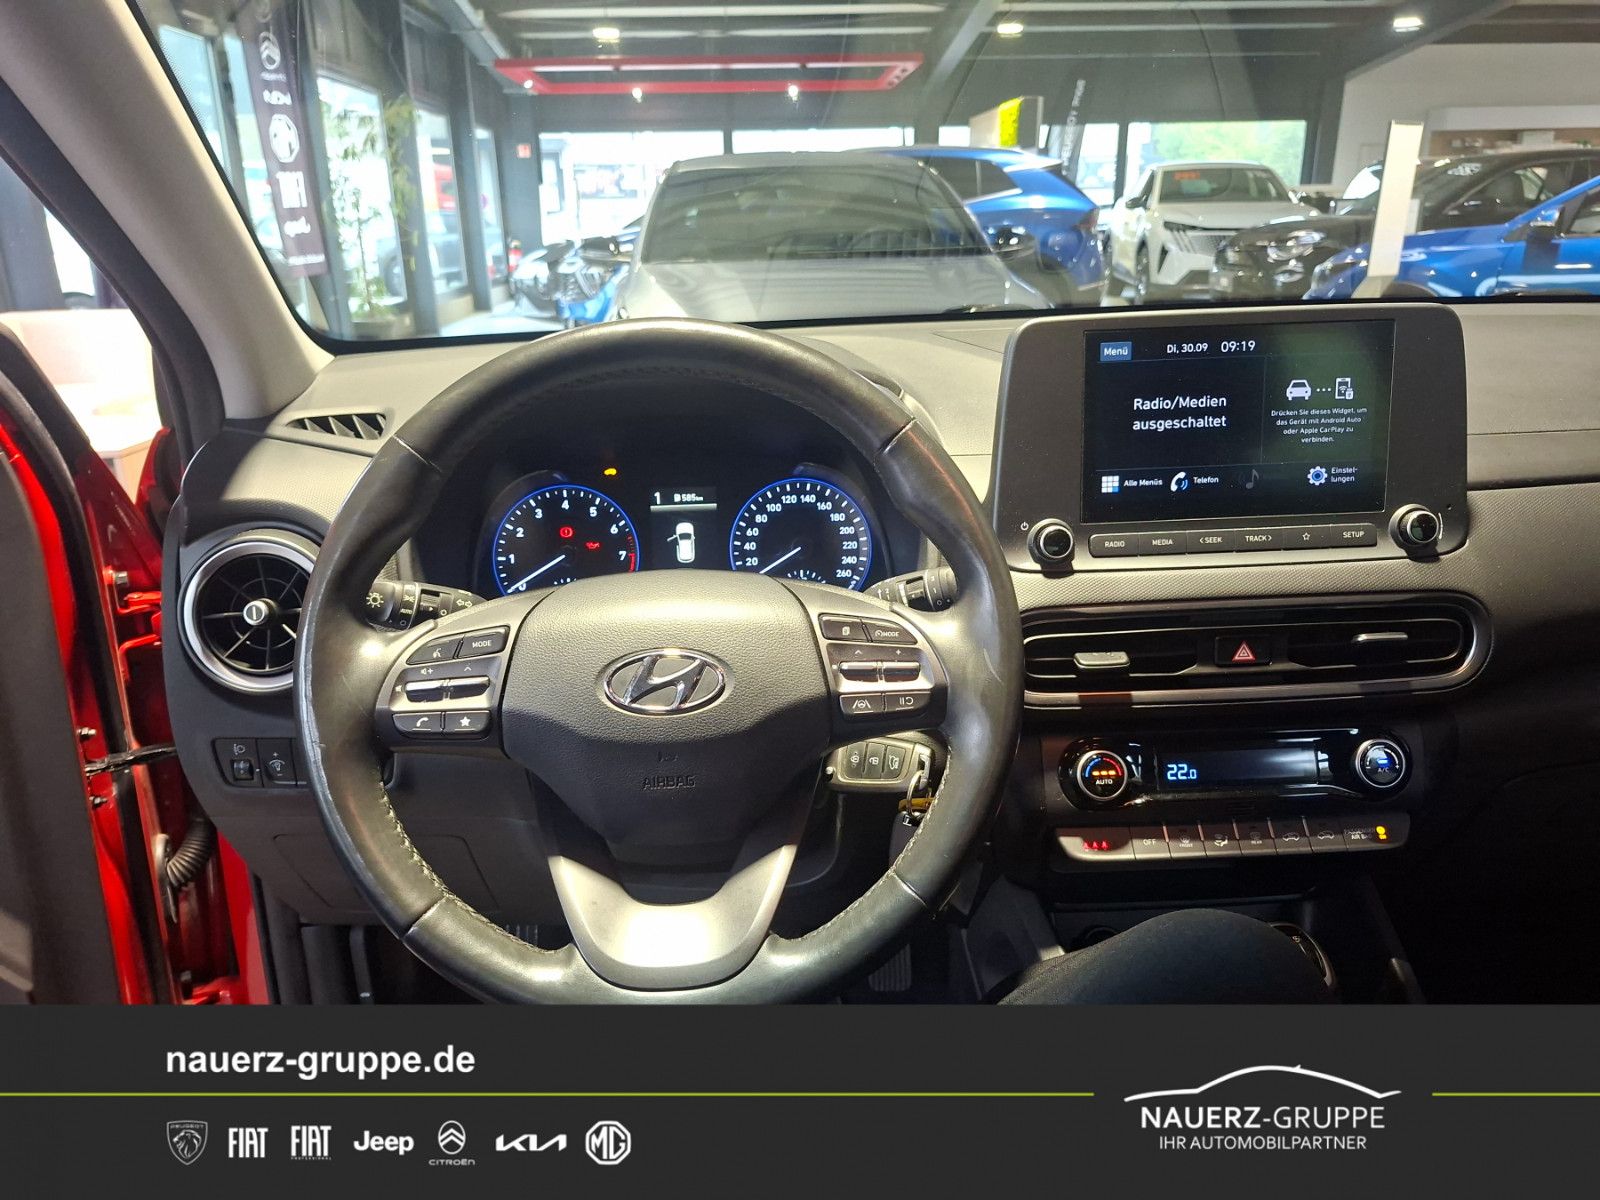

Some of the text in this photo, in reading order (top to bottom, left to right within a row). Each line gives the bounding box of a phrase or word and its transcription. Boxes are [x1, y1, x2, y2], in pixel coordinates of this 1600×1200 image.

[1103, 346, 1128, 356] Menü
[1166, 342, 1209, 354] Di, 30.09
[1220, 340, 1256, 353] 09:19
[1133, 395, 1227, 411] Radio/Medien
[1132, 416, 1227, 431] ausgeschaltet
[1320, 416, 1345, 424] Android
[1299, 427, 1318, 435] Apple
[1319, 426, 1344, 434] CarPlay
[1139, 478, 1163, 487] Menüs
[1193, 475, 1219, 485] Telefon
[1331, 475, 1355, 483] lungen
[654, 491, 661, 505] 1
[781, 495, 797, 504] 120
[800, 495, 816, 503] 140
[561, 499, 570, 509] 4
[766, 503, 782, 512] 100
[817, 502, 832, 510] 160
[535, 508, 543, 519] 3
[589, 506, 598, 517] 5
[755, 514, 768, 523] 80
[830, 513, 845, 521] 180
[515, 526, 525, 538] 2
[610, 523, 619, 534] 6
[746, 527, 759, 536] 60
[839, 526, 854, 535] 200
[1342, 530, 1366, 540] SETUP
[743, 541, 757, 551] 40
[842, 541, 857, 550] 220
[1104, 539, 1126, 549] RADIO
[1152, 537, 1174, 547] MEDIA
[508, 553, 515, 565] 1
[618, 550, 627, 561] 7
[841, 556, 857, 565] 240
[745, 557, 759, 566] 20
[836, 569, 852, 577] 260
[472, 640, 492, 648] MODE
[1166, 763, 1198, 780] 22.0
[641, 775, 697, 791] AIRBAG
[1142, 838, 1156, 846] OFF
